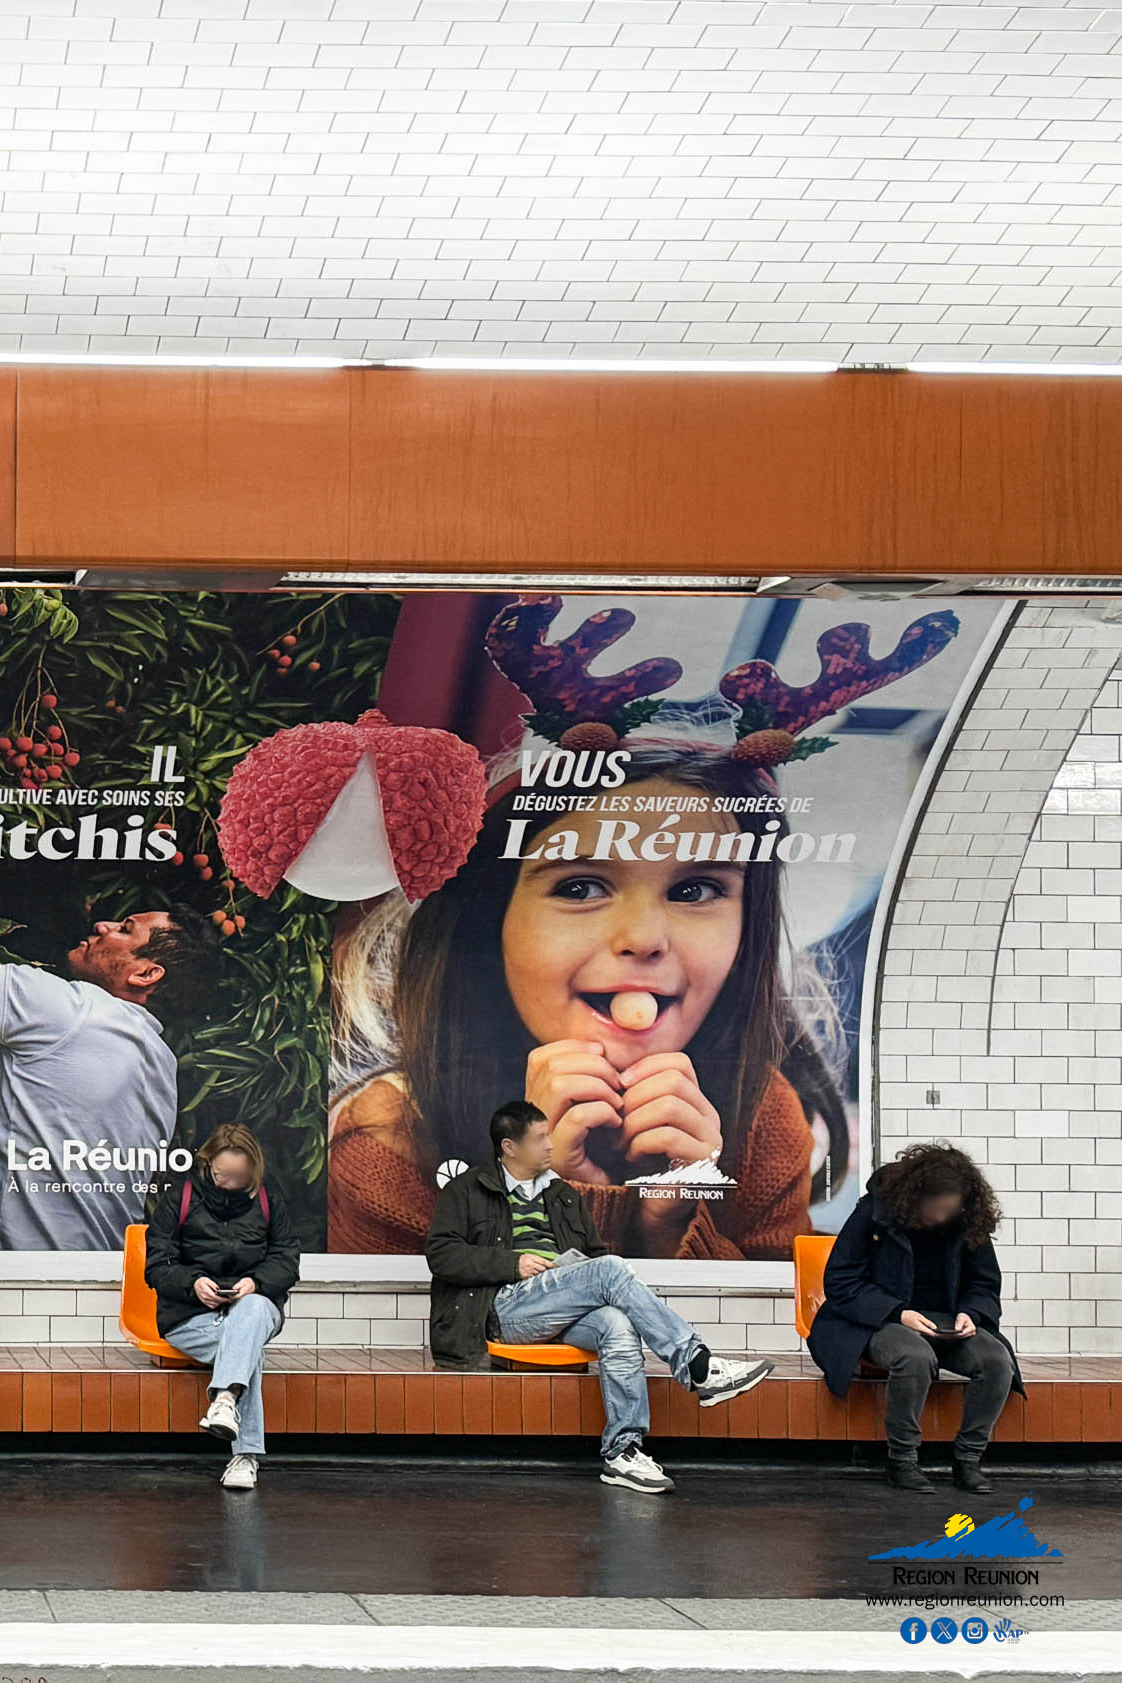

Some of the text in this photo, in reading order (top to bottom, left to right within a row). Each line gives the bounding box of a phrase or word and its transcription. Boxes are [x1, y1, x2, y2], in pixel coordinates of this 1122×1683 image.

[150, 745, 185, 783] IL
[520, 750, 631, 788] VOUS
[55, 789, 98, 805] AVEC
[102, 790, 151, 806] SOINS
[153, 791, 185, 806] SES
[512, 794, 814, 813] DÉGUSTEZ LES SAVEURS SUCRÉES DE
[497, 814, 857, 863] La Réunion
[7, 1138, 194, 1172] La Réunio
[8, 1176, 20, 1193] À
[26, 1180, 39, 1193] la
[45, 1182, 126, 1193] rencontre
[131, 1180, 158, 1194] des
